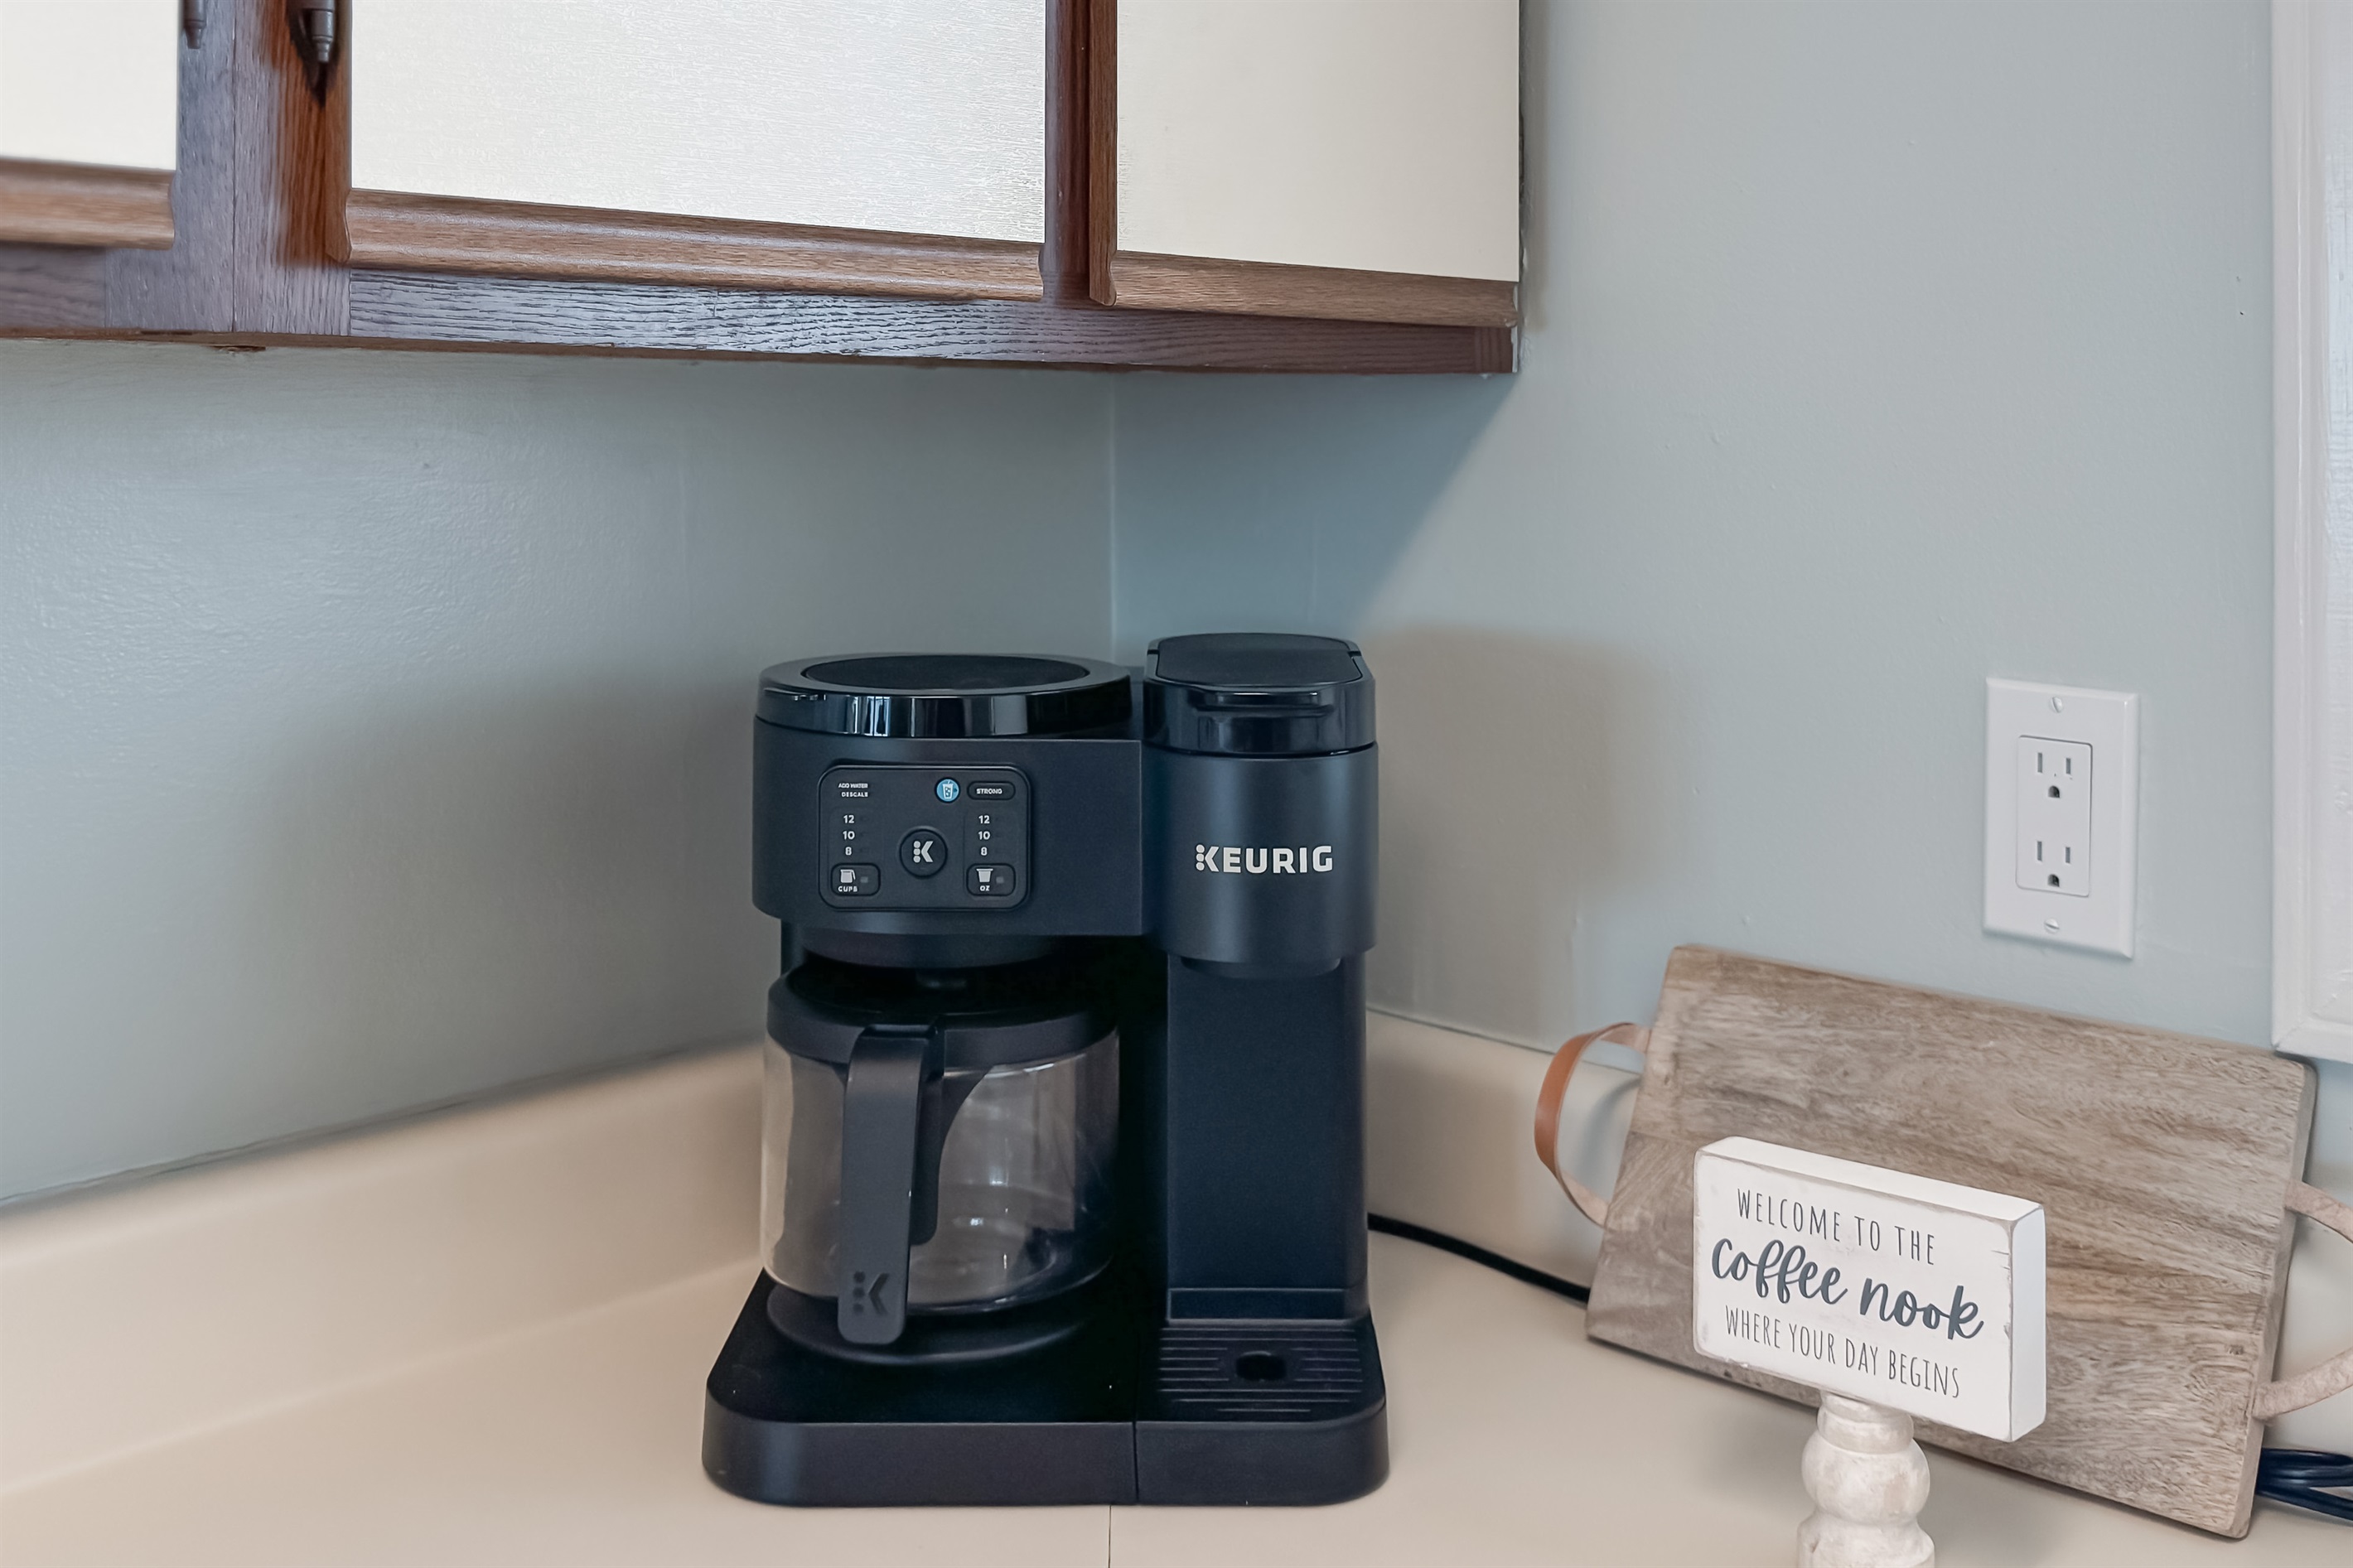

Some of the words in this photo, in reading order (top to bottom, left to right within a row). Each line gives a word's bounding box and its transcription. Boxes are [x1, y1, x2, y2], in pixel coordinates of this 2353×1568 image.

[843, 814, 855, 824] 12
[978, 815, 990, 824] 12
[843, 831, 855, 840] 10
[978, 831, 991, 840] 10
[845, 847, 853, 856] 8
[980, 847, 988, 856] 8
[1196, 844, 1333, 874] KEURIG
[1737, 1187, 1841, 1242] WELCOME
[1854, 1215, 1881, 1252] TO
[1894, 1225, 1935, 1266] THE
[1859, 1277, 1984, 1340] nook
[1725, 1305, 1780, 1349] WHERE
[1789, 1323, 1836, 1364] YOUR
[1845, 1338, 1879, 1376] DAY
[1888, 1349, 1959, 1399] BEGINS
